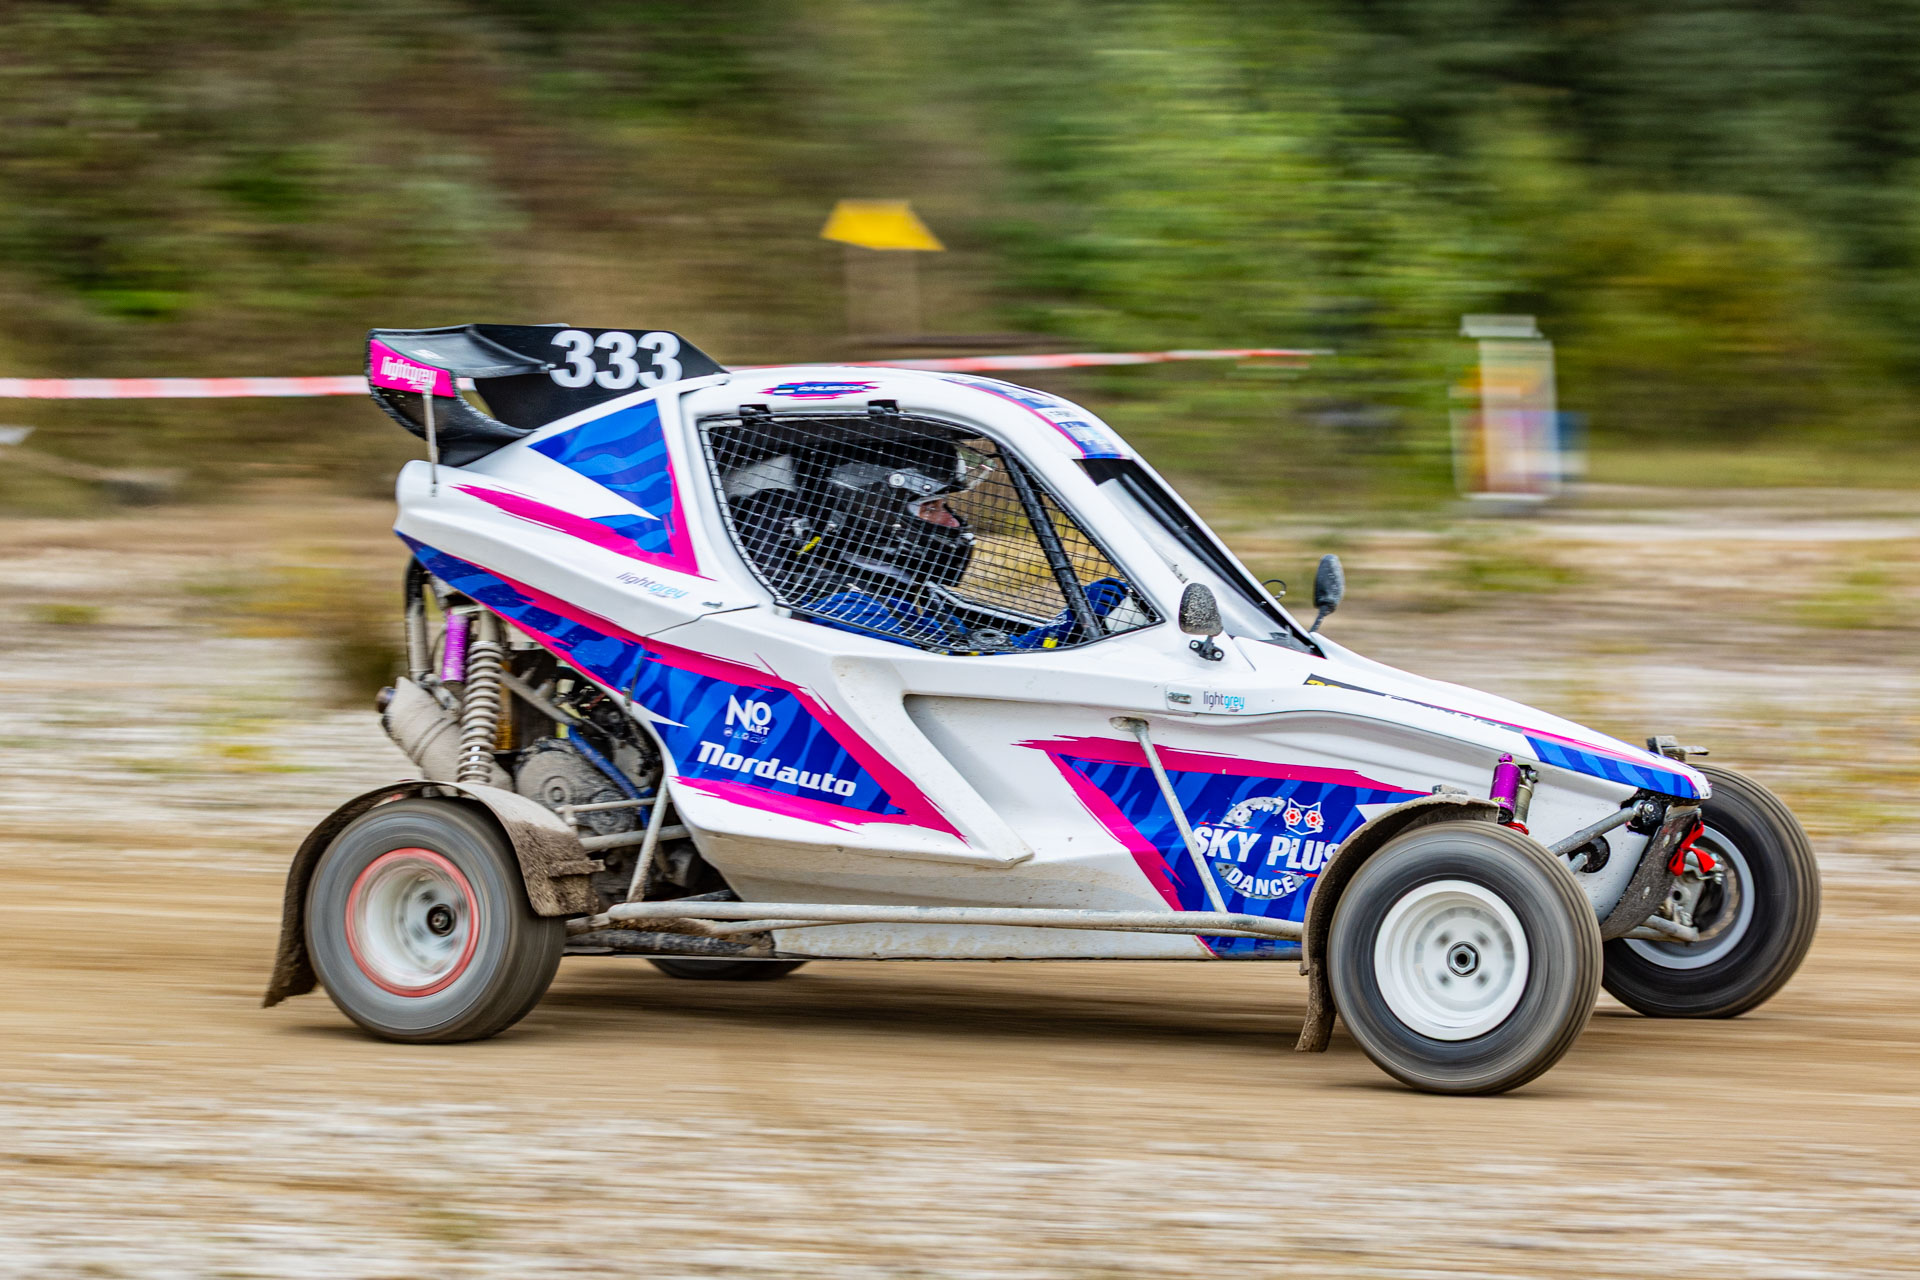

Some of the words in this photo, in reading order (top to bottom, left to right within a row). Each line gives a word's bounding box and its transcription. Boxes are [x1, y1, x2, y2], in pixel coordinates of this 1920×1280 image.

[550, 330, 683, 389] 333
[616, 572, 688, 599] lightgrey
[725, 694, 772, 731] NO
[1203, 691, 1245, 709] lightgrey
[748, 724, 770, 736] ART
[1193, 826, 1262, 863] SKY
[1226, 868, 1297, 896] DANCE
